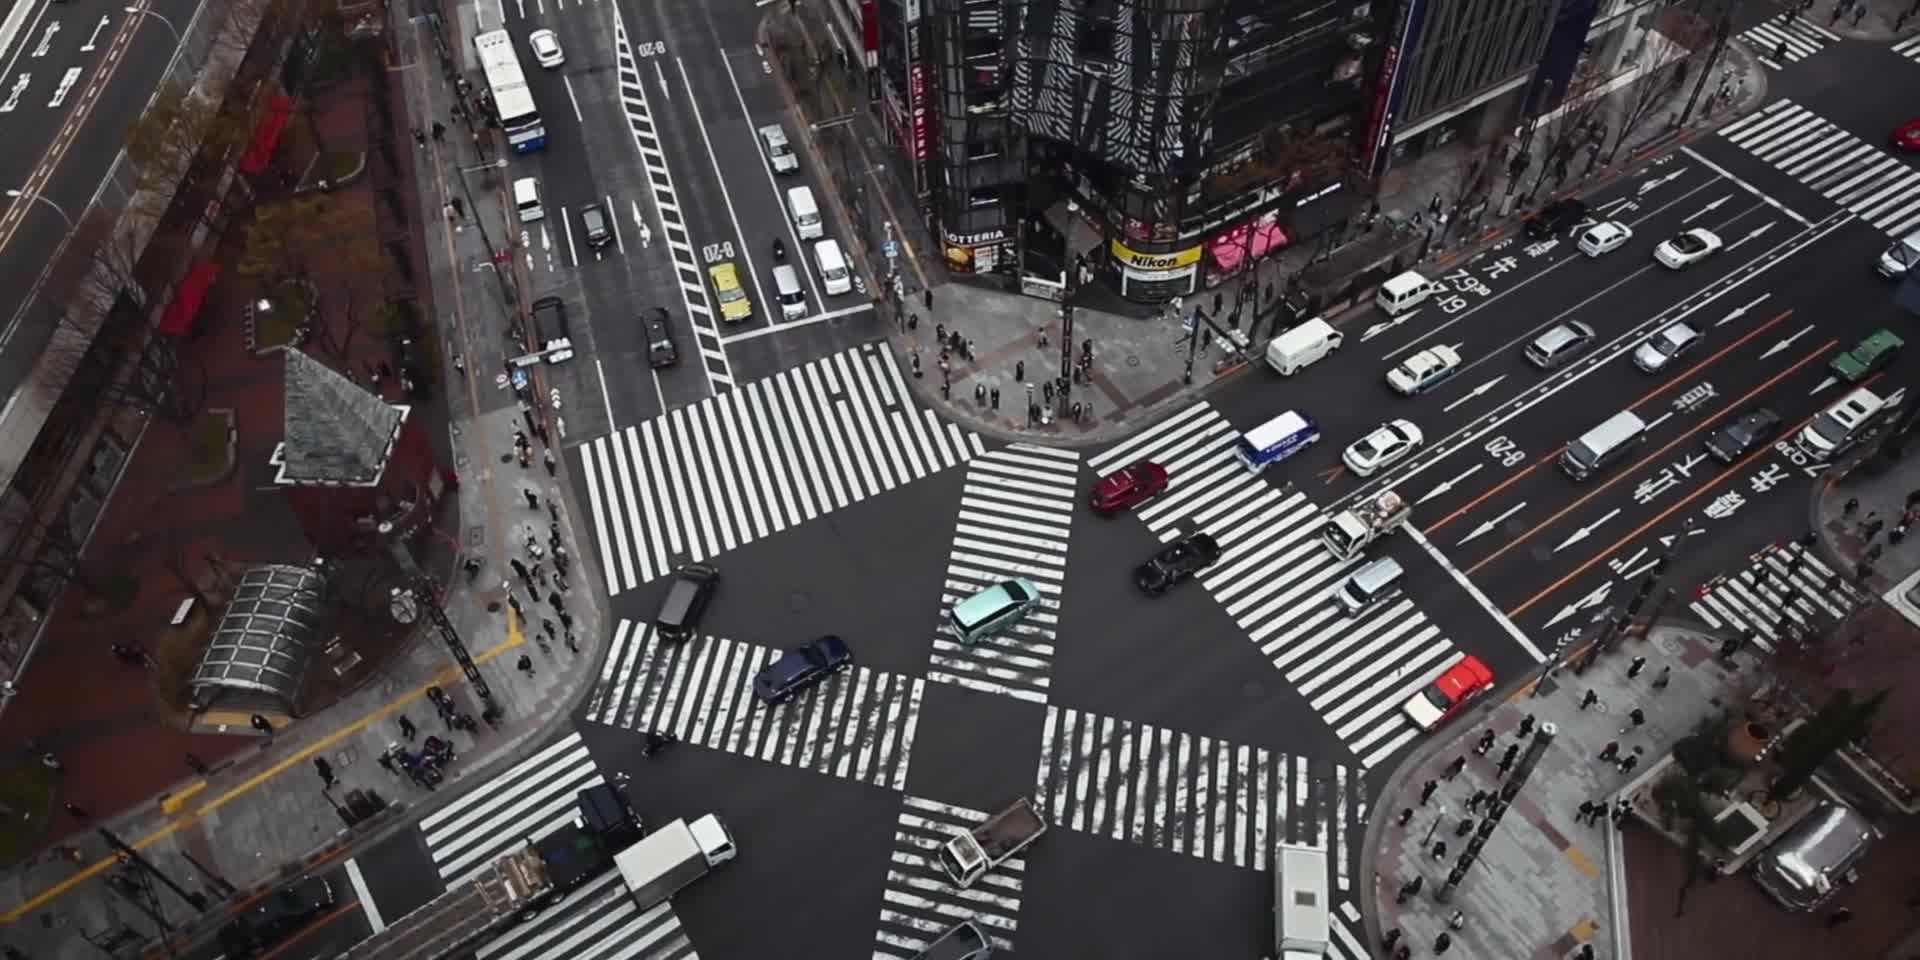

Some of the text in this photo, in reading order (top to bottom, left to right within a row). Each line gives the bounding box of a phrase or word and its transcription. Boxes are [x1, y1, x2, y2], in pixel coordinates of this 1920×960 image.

[638, 40, 666, 57] 8-20
[943, 228, 1004, 244] LOTTERIA
[702, 241, 735, 263] 8-20
[1131, 254, 1177, 268] Nikon
[1485, 435, 1526, 467] 8-20
